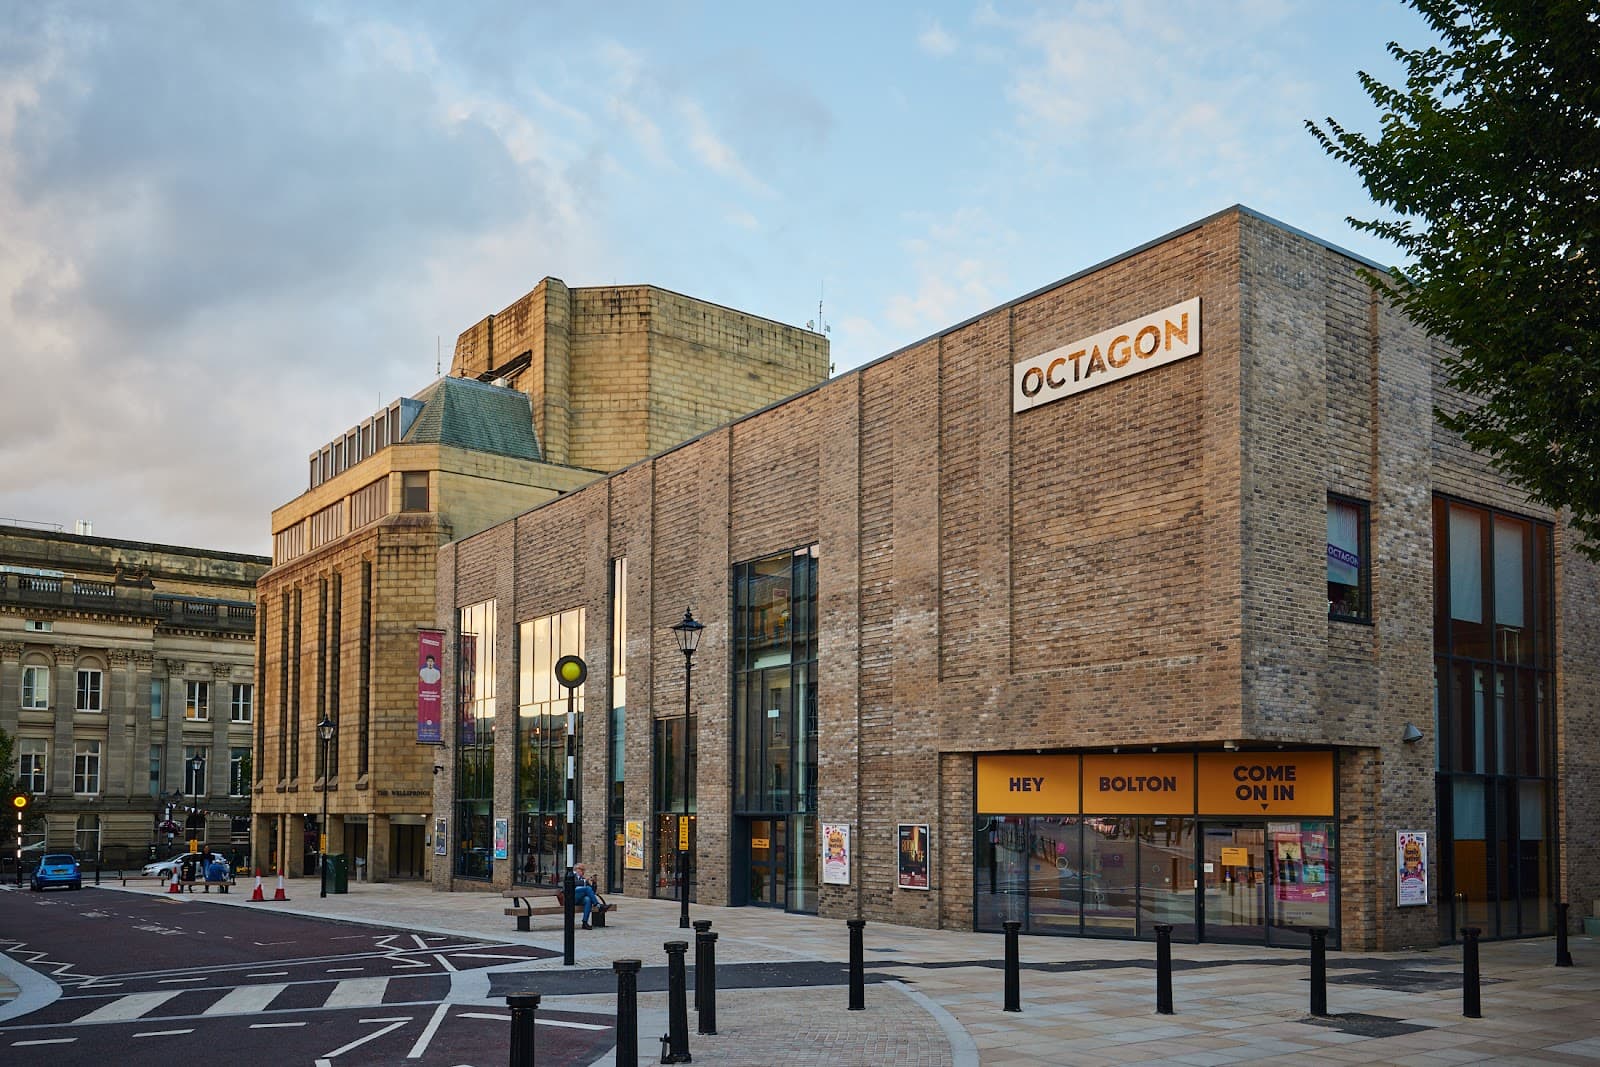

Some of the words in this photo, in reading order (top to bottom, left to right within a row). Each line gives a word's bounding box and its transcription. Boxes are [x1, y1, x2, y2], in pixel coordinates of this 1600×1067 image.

[1021, 312, 1189, 399] OCTAGON
[1328, 545, 1359, 567] OCTAGON
[1233, 765, 1297, 782] COME
[1009, 776, 1045, 792] HEY
[1099, 776, 1177, 792] BOLTON
[1235, 784, 1268, 801] ON
[1273, 784, 1295, 801] IN
